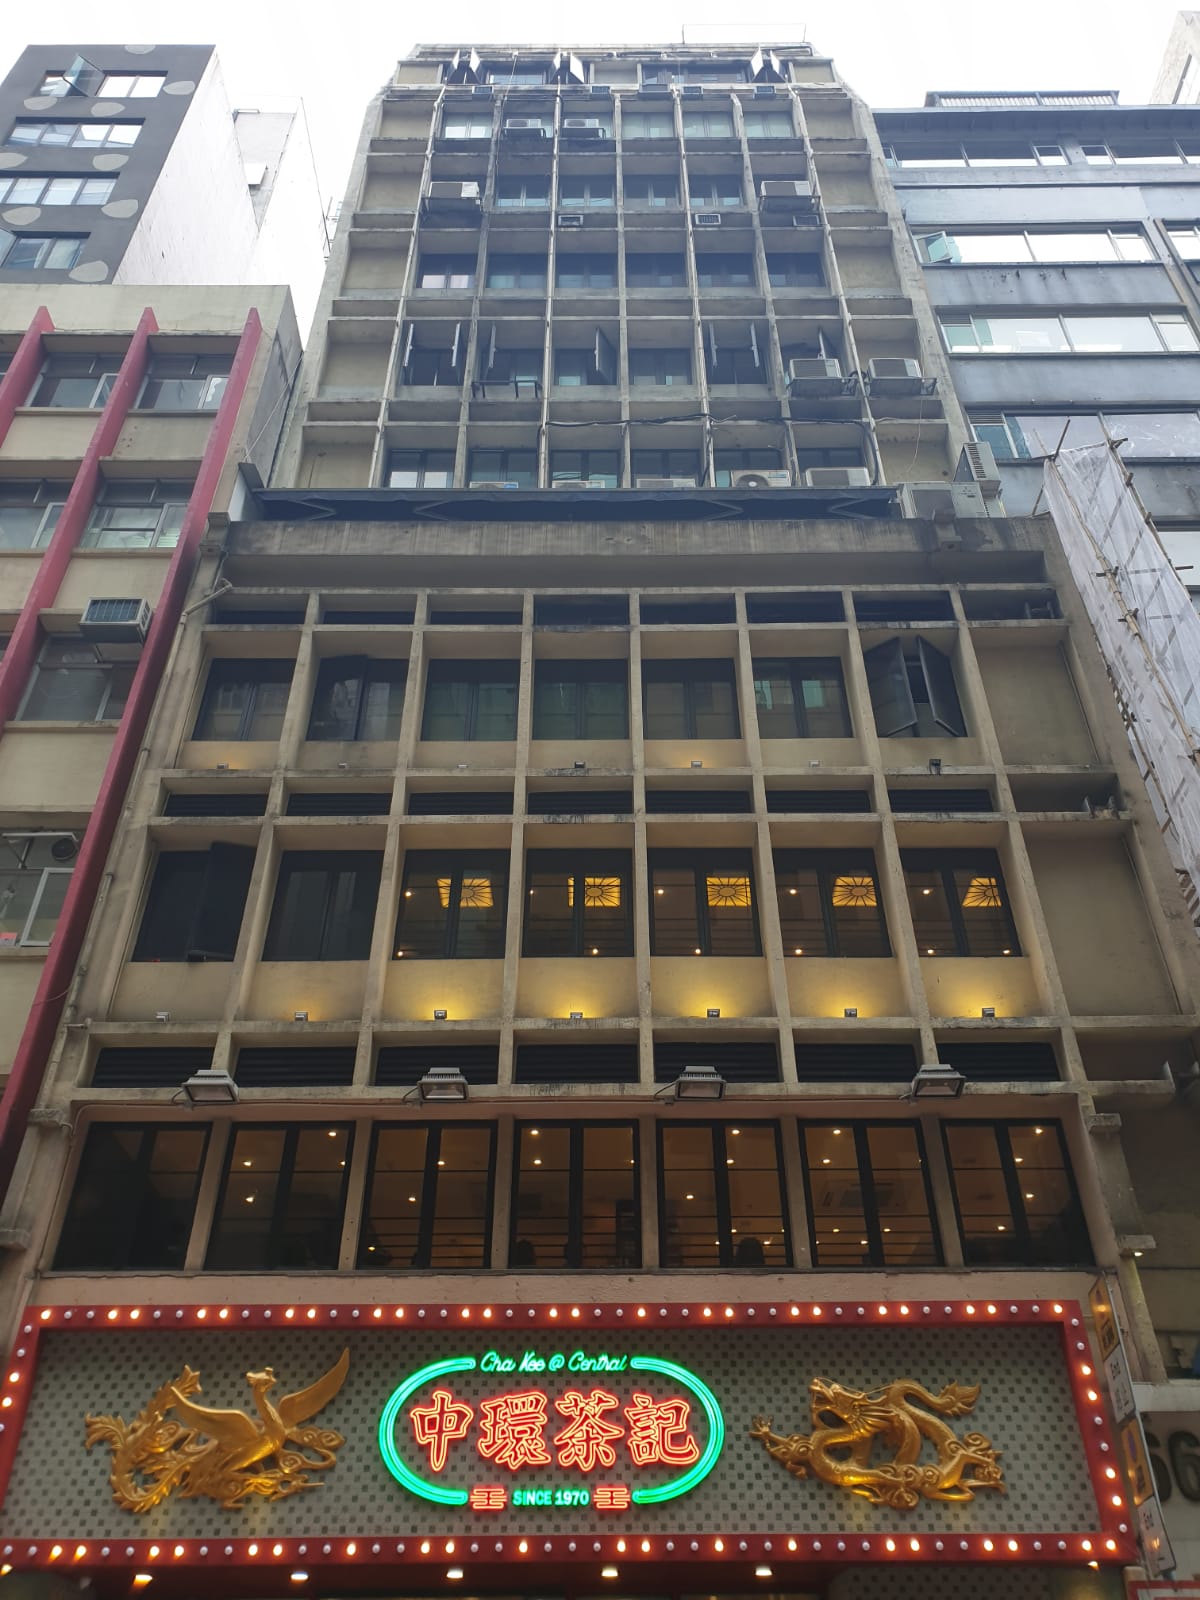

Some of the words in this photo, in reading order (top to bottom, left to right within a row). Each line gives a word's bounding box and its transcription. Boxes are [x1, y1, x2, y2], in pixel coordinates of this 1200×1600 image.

[480, 1350, 516, 1372] Cha
[518, 1350, 546, 1372] Kee
[548, 1353, 565, 1371] @
[568, 1350, 627, 1372] Central
[410, 1389, 700, 1473] 中環茶記
[512, 1489, 552, 1506] SINCE
[554, 1489, 590, 1506] 1970
